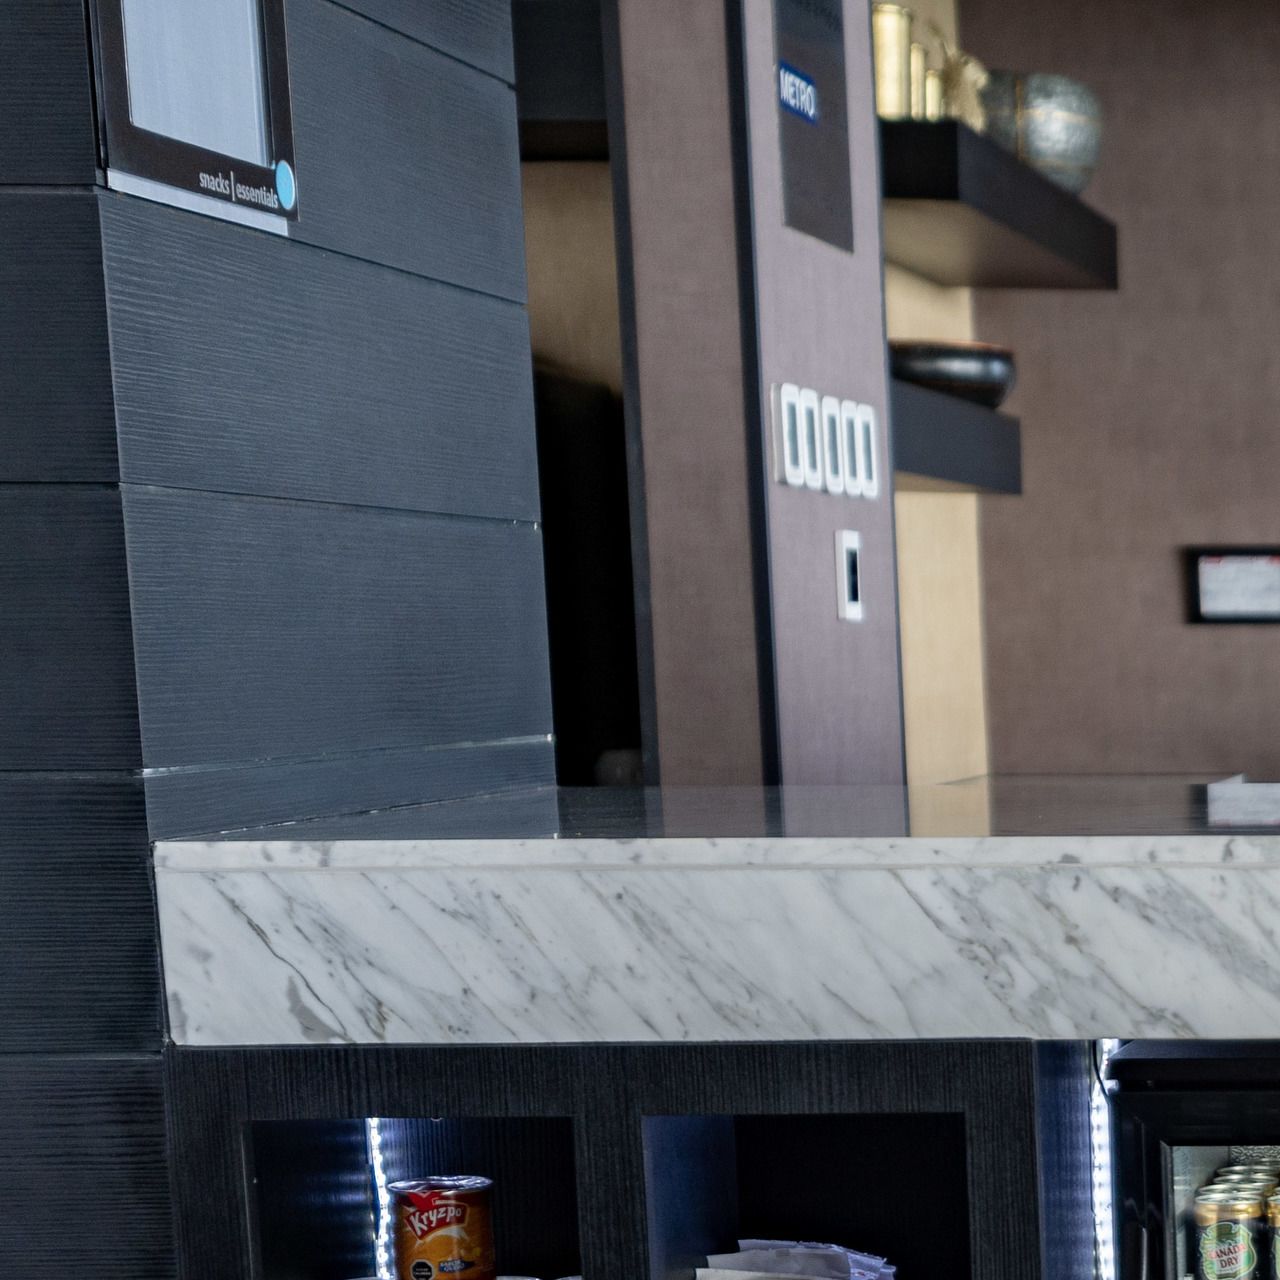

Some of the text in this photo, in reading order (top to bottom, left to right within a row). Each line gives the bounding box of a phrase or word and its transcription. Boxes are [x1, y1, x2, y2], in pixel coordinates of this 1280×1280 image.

[780, 67, 815, 118] METRO
[199, 172, 279, 208] snacks essentials
[410, 1206, 462, 1237] Kryzpo
[1219, 1255, 1241, 1269] DRY
